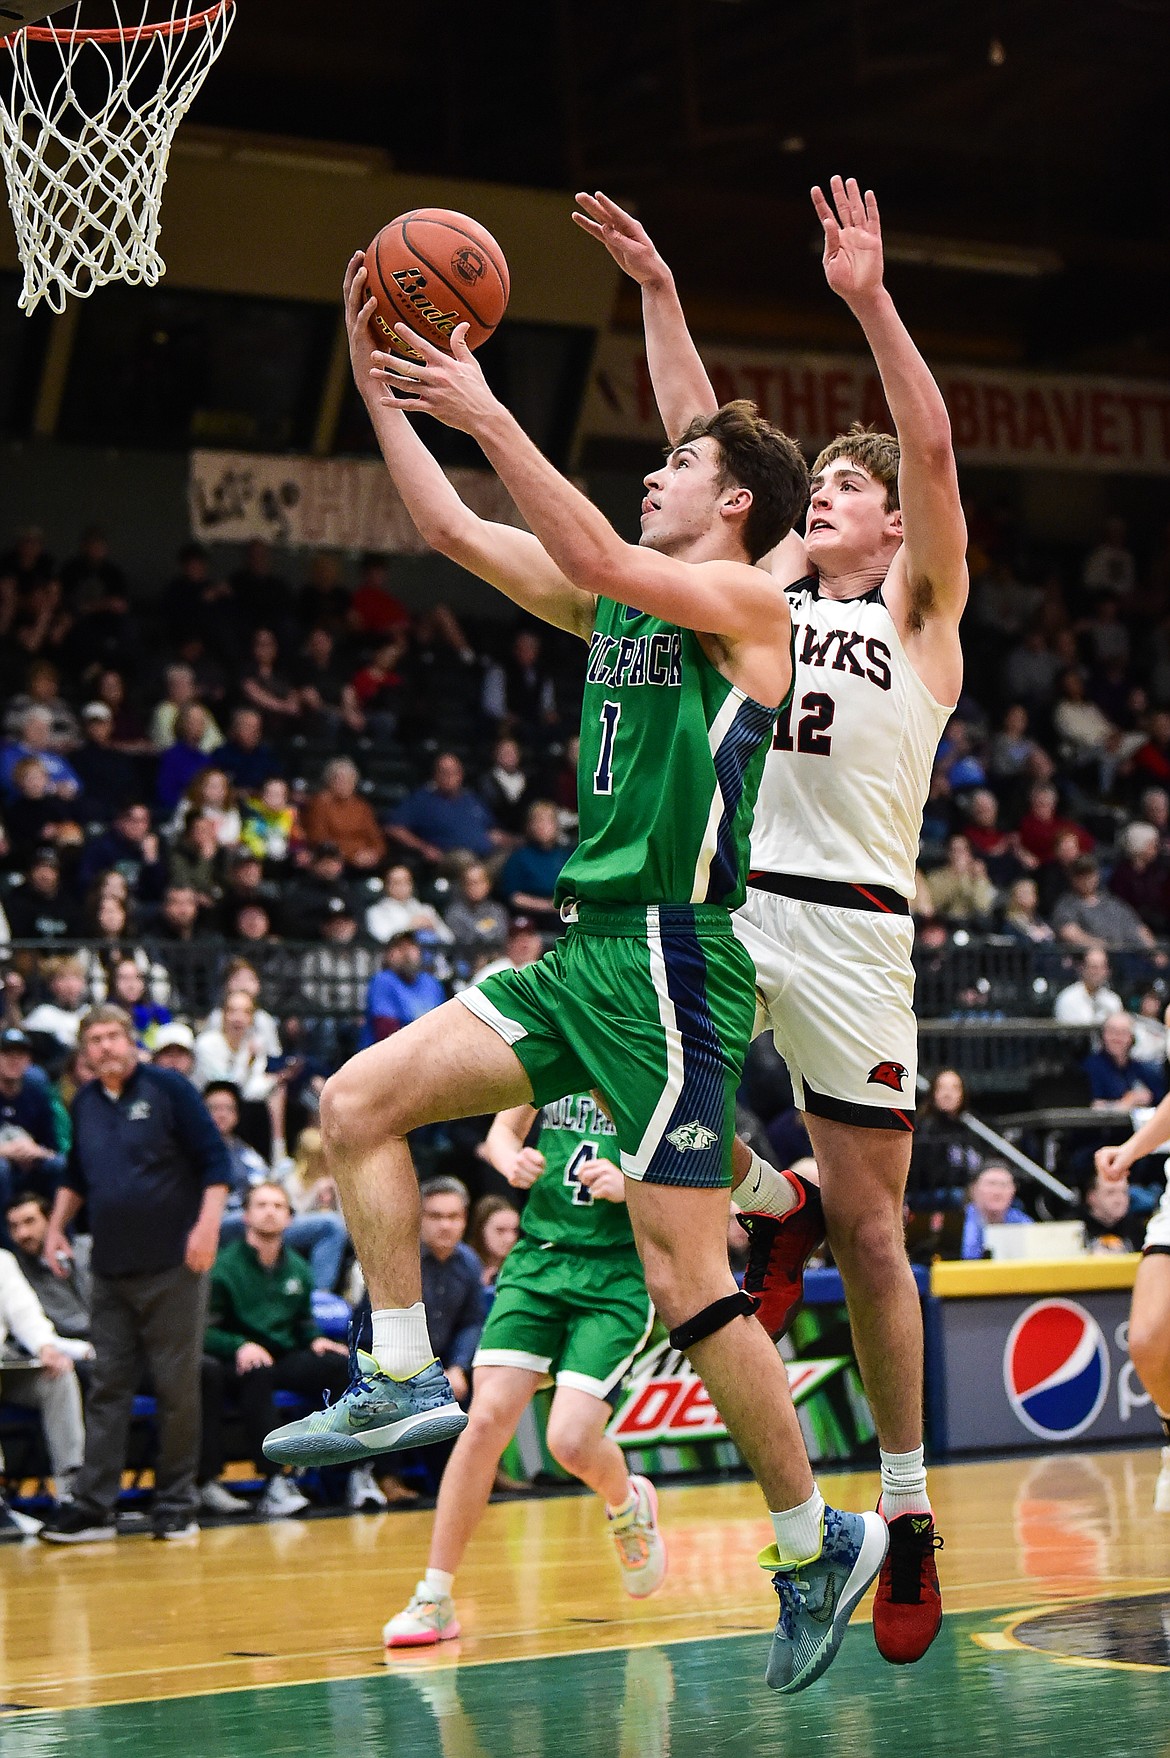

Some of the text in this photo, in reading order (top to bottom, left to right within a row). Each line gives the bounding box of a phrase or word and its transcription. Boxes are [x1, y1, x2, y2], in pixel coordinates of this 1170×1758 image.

[390, 266, 469, 339] Bade
[794, 623, 892, 692] WKS
[593, 700, 621, 796] 1
[772, 691, 836, 757] 12
[563, 1140, 600, 1207] 4
